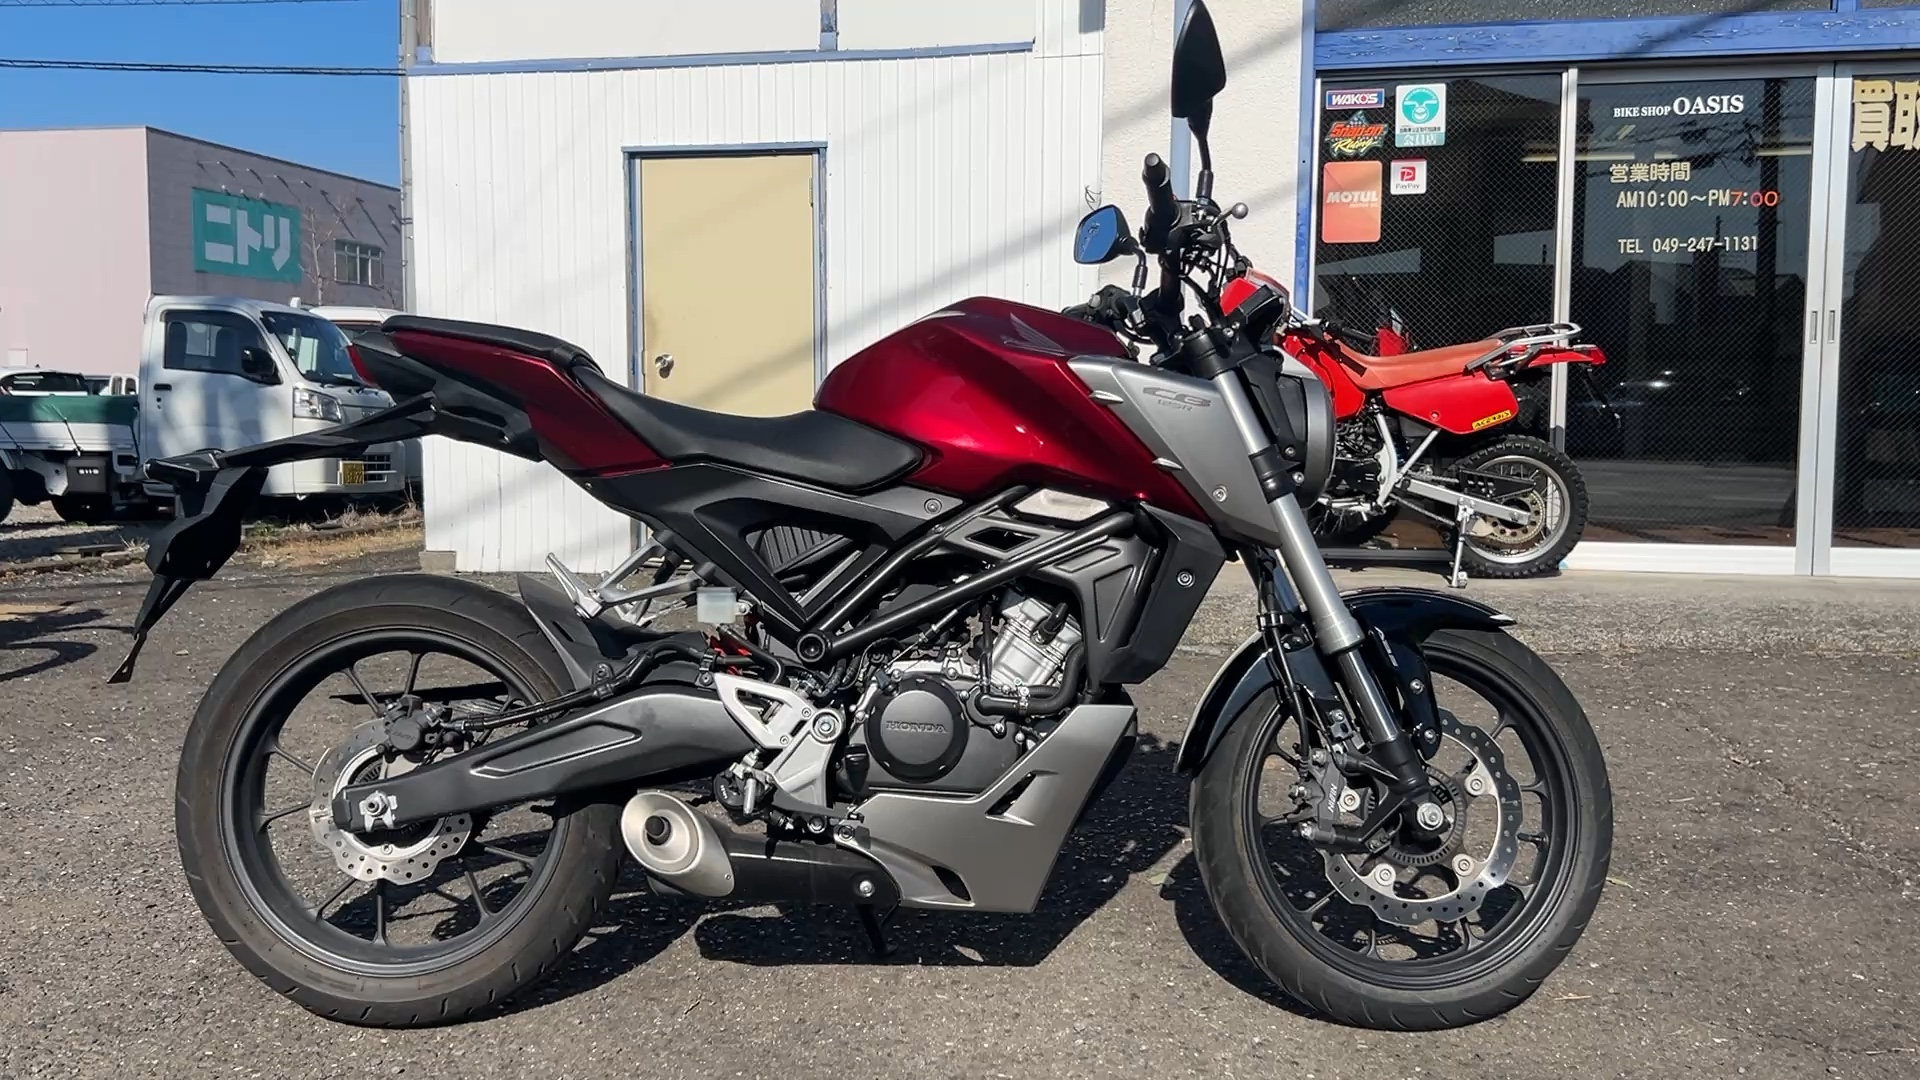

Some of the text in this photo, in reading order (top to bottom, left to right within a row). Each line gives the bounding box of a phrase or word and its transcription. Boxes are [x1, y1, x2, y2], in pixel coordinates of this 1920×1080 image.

[1613, 94, 1745, 118] BIKE SHOP OASIS
[1609, 161, 1691, 184] 営業時間
[1326, 190, 1379, 204] MOTUL
[205, 203, 292, 272] ニトリ
[1618, 235, 1758, 254] TEL 049-247-1131
[1142, 386, 1212, 407] CB
[885, 720, 948, 734] HONDA
